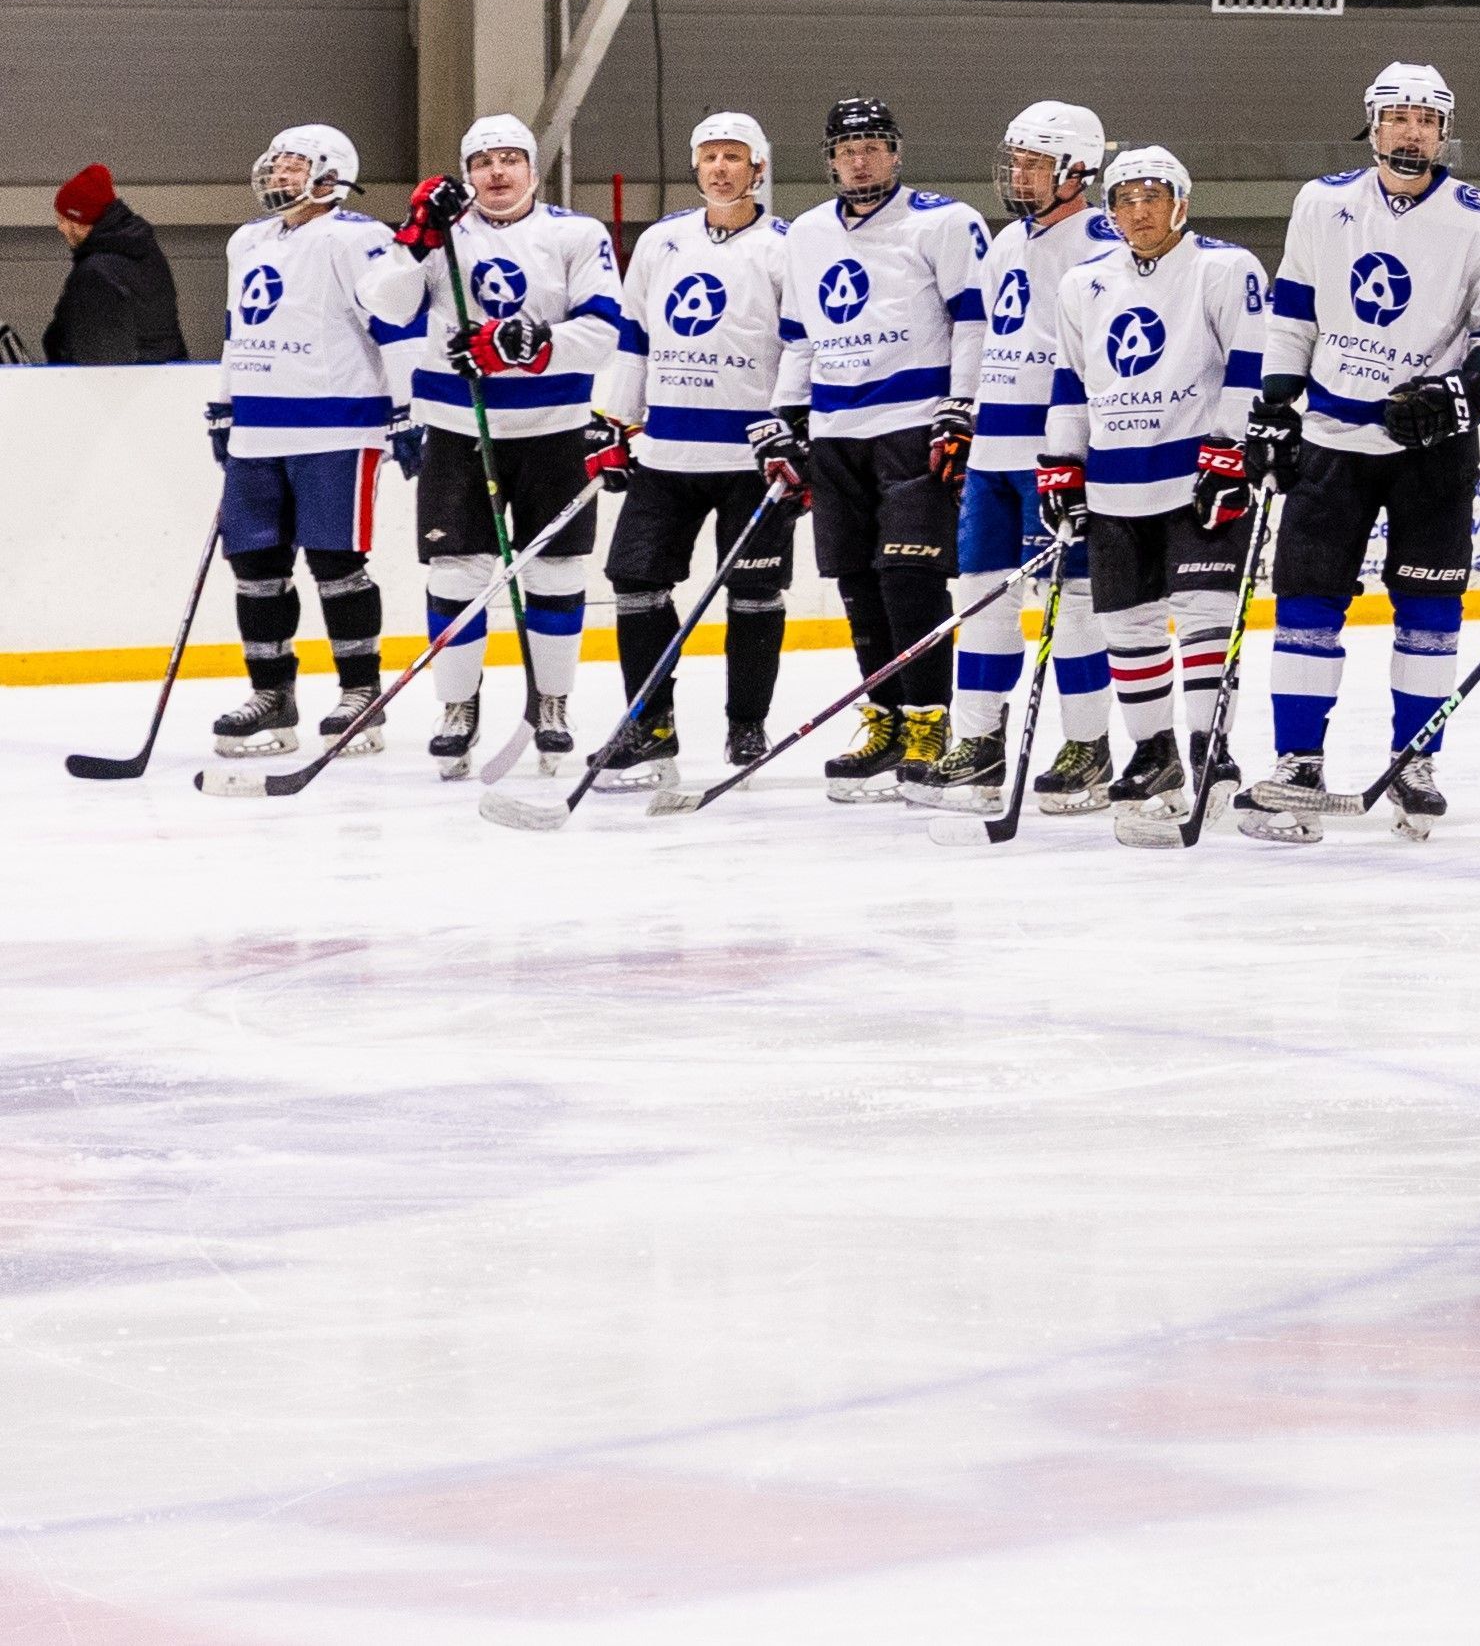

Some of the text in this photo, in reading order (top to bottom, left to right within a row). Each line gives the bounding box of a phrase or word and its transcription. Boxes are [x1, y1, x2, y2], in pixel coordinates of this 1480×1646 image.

[281, 342, 313, 355] АЭС
[812, 329, 910, 351] ОЯРСКАЯ АЭС
[653, 349, 757, 370] ОЯРСКАЯ АЭС
[1246, 422, 1291, 441] CM
[1037, 471, 1073, 487] CM
[883, 543, 943, 557] CCM
[1409, 689, 1463, 752] CCM
